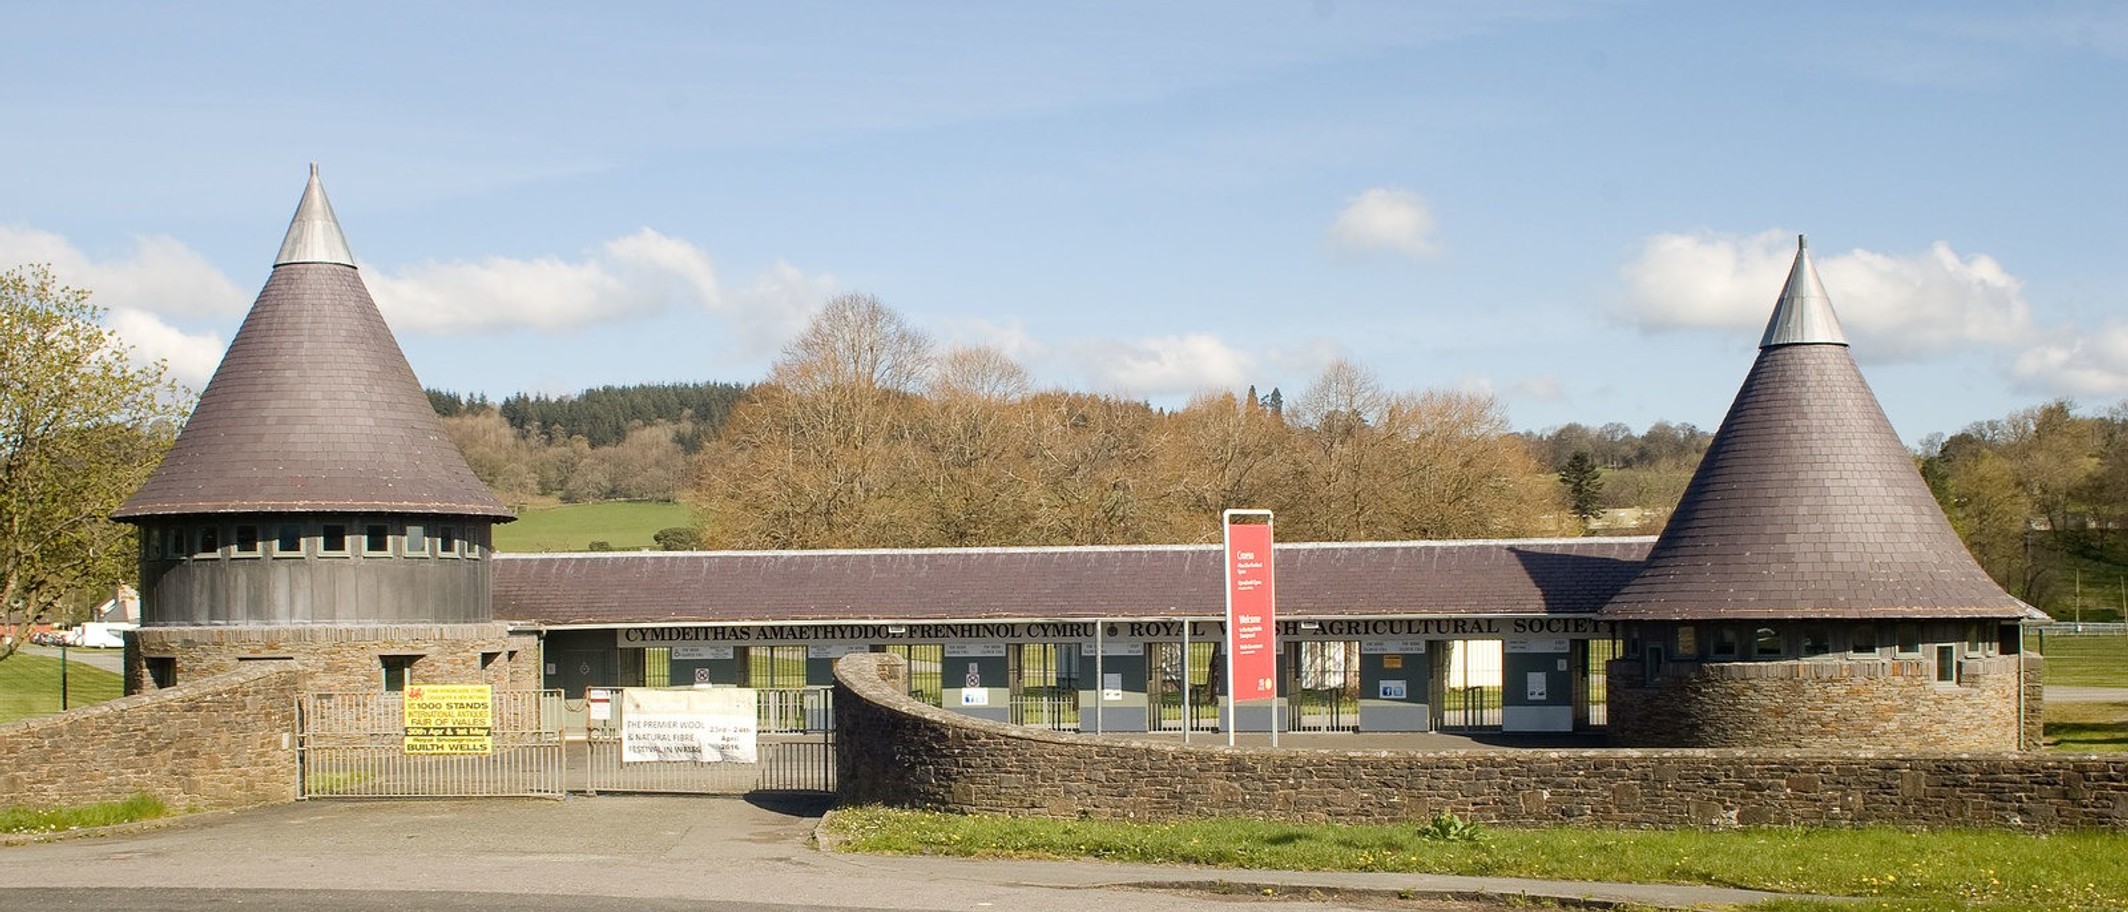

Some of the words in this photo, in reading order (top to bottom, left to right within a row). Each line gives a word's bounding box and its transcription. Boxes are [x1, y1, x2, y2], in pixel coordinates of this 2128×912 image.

[1128, 622, 1205, 636] ROYAL
[1312, 620, 1499, 635] AGRICULTURAL
[625, 627, 750, 642] CYMDEITHAS
[906, 624, 1021, 638] FRENHINOL
[1027, 623, 1095, 637] CYMRU
[446, 702, 489, 710] STANDS
[457, 710, 488, 718] ANTIQUES
[627, 721, 641, 729] THE
[643, 721, 678, 729] PREMIER
[680, 721, 705, 729] WOOL
[407, 728, 426, 736] 30th
[428, 728, 445, 736] Apr
[445, 728, 454, 736] &
[455, 728, 468, 736] 1st
[469, 728, 489, 736] May
[627, 733, 634, 741] &
[635, 733, 671, 741] NATURAL
[673, 733, 694, 741] FIBRE
[629, 745, 664, 753] FESTIVAL
[664, 745, 673, 753] IN
[675, 745, 702, 754] WALES
